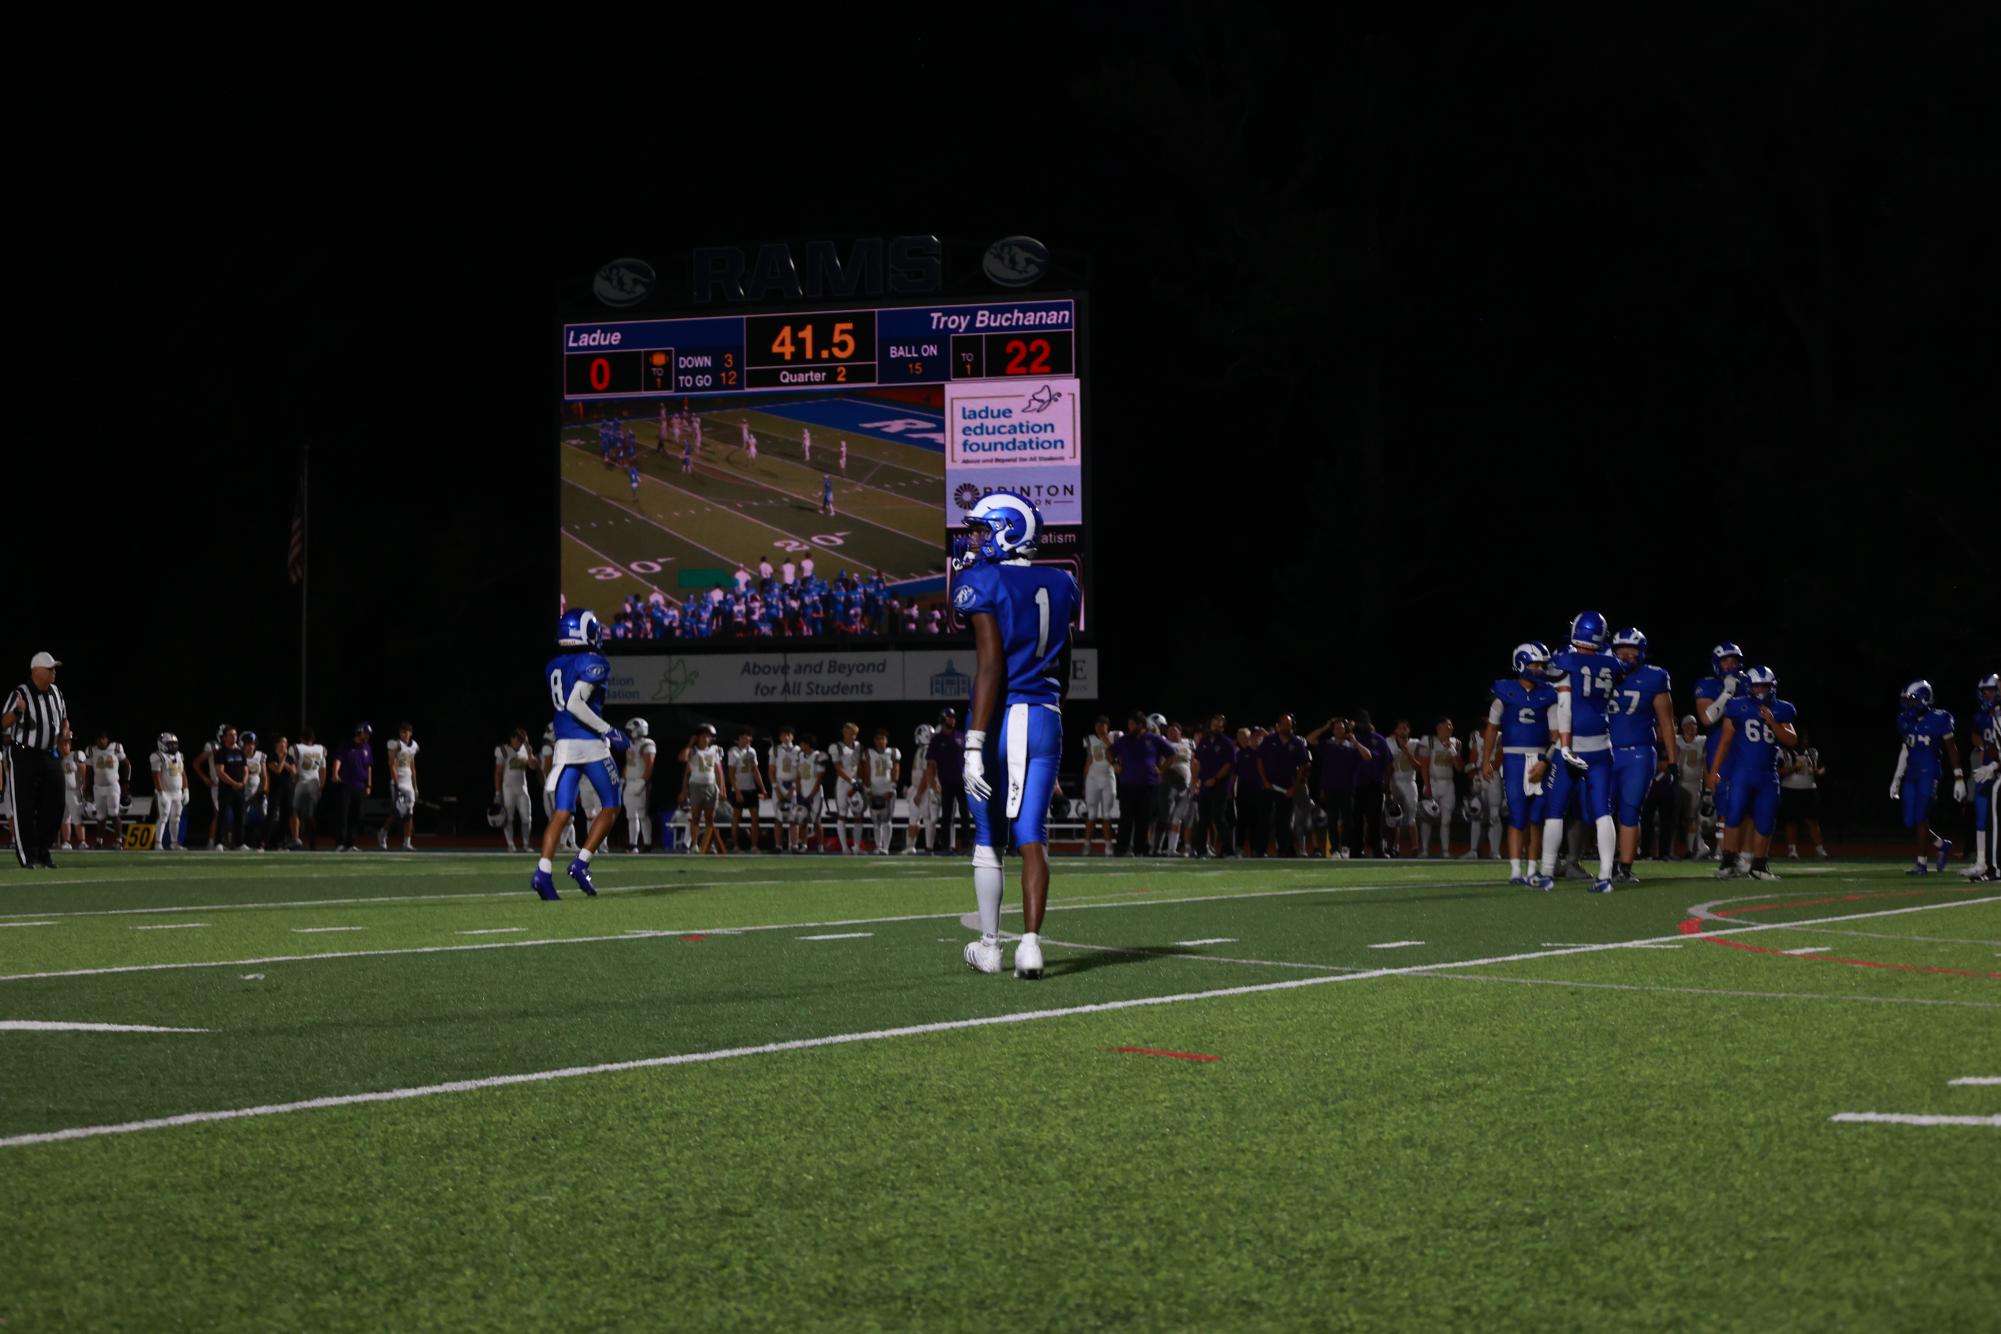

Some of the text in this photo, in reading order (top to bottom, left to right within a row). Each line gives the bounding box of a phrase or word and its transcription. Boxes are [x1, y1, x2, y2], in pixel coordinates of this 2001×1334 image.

[692, 234, 942, 304] RAMS
[930, 308, 1071, 332] Troy Buchanan
[568, 329, 622, 347] Ladue
[770, 322, 856, 360] 41.5
[889, 344, 938, 358] BALL ON
[960, 352, 974, 363] TO
[1004, 338, 1053, 374] 22
[678, 353, 736, 368] DOWN 3
[907, 361, 923, 376] 15
[963, 363, 972, 375] 1
[588, 356, 612, 392] 0
[678, 370, 738, 388] TO GO 12
[779, 365, 848, 384] Quarter 2
[961, 405, 1013, 420] ladue
[961, 420, 1055, 436] education
[961, 437, 1065, 453] foundation
[1034, 587, 1050, 658] 1
[740, 659, 887, 676] Above and Beyond
[550, 668, 565, 712] 8
[755, 681, 873, 696] for All Students
[1580, 665, 1614, 698] 14
[1745, 718, 1777, 744] 66
[127, 824, 151, 847] 50
